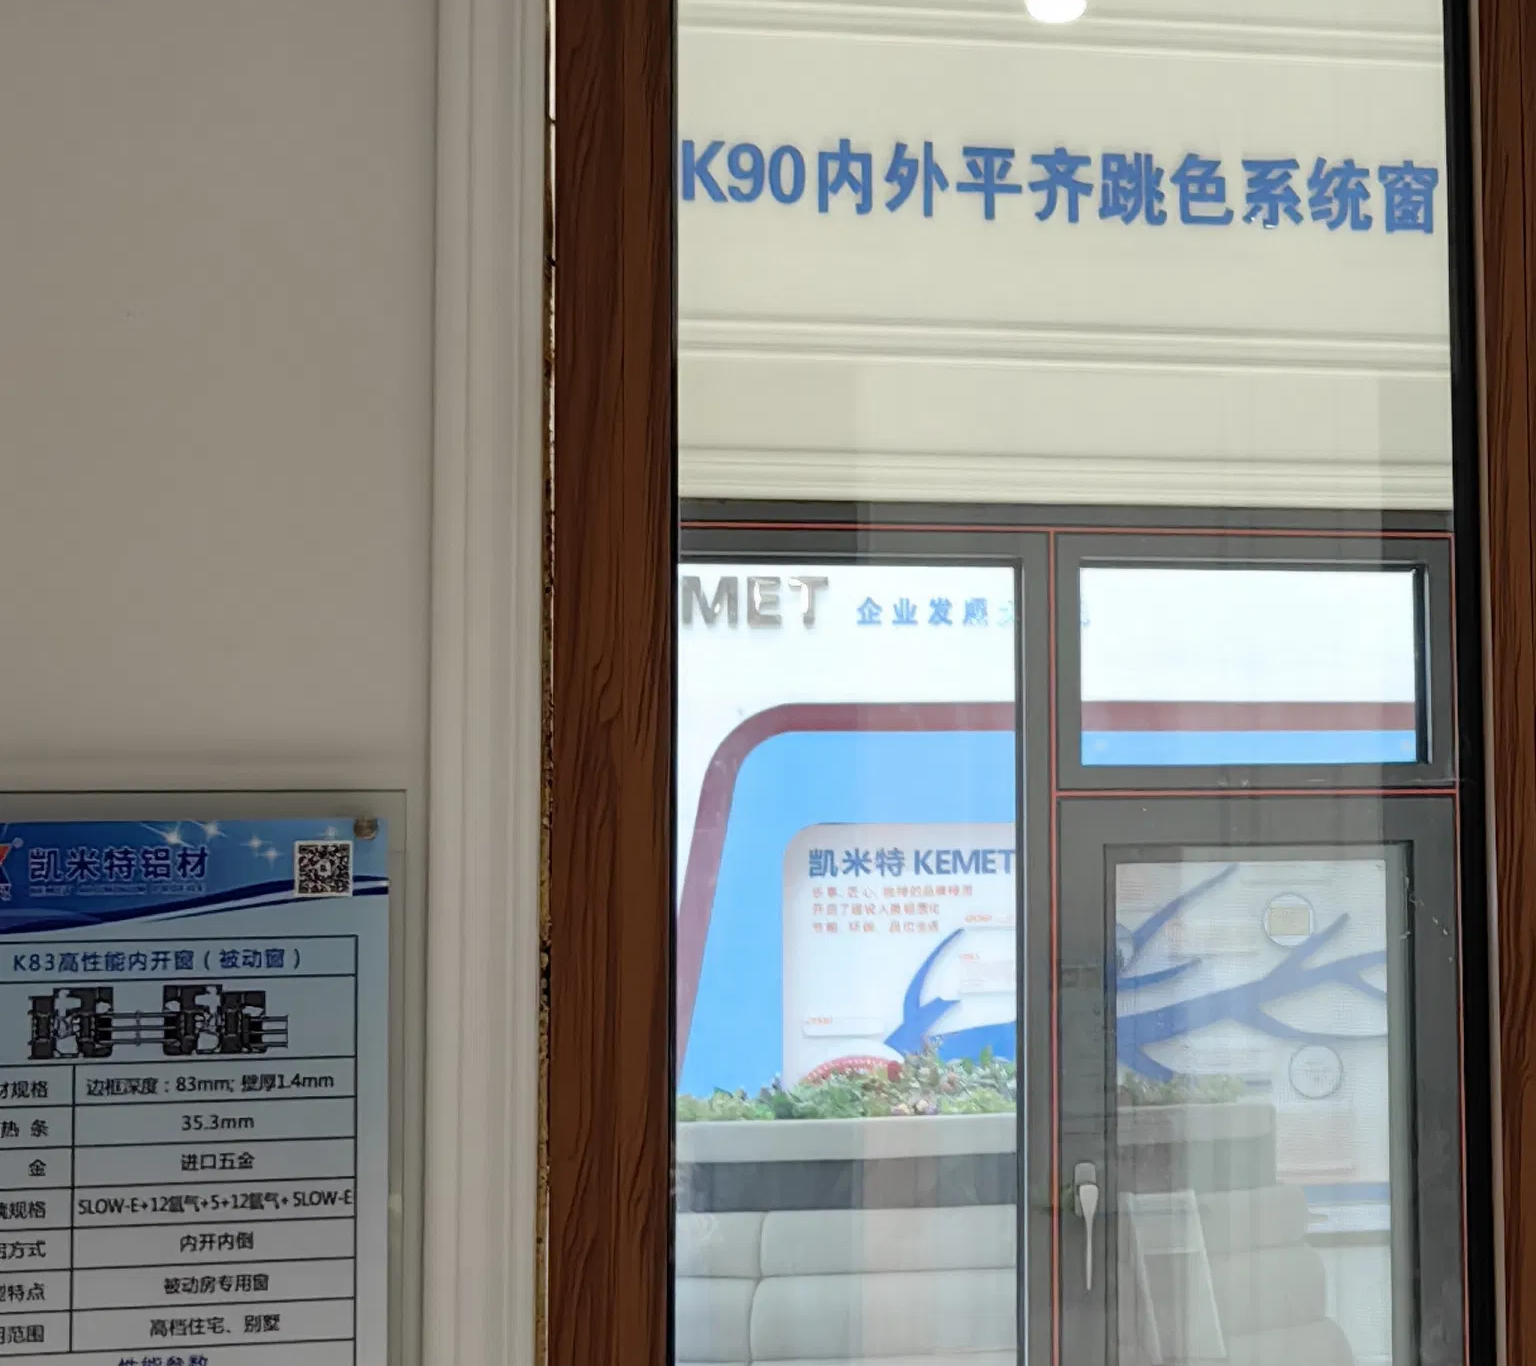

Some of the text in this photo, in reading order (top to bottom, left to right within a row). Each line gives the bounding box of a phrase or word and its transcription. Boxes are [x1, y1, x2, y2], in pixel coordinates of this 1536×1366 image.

[680, 138, 1440, 235] K90内外平齐跳色系统窗
[28, 846, 209, 882] 凯米特铝材
[808, 847, 1016, 878] 凯米特 KEMET
[181, 1114, 255, 1131] 35.3mm
[181, 1151, 255, 1171] 进口五金
